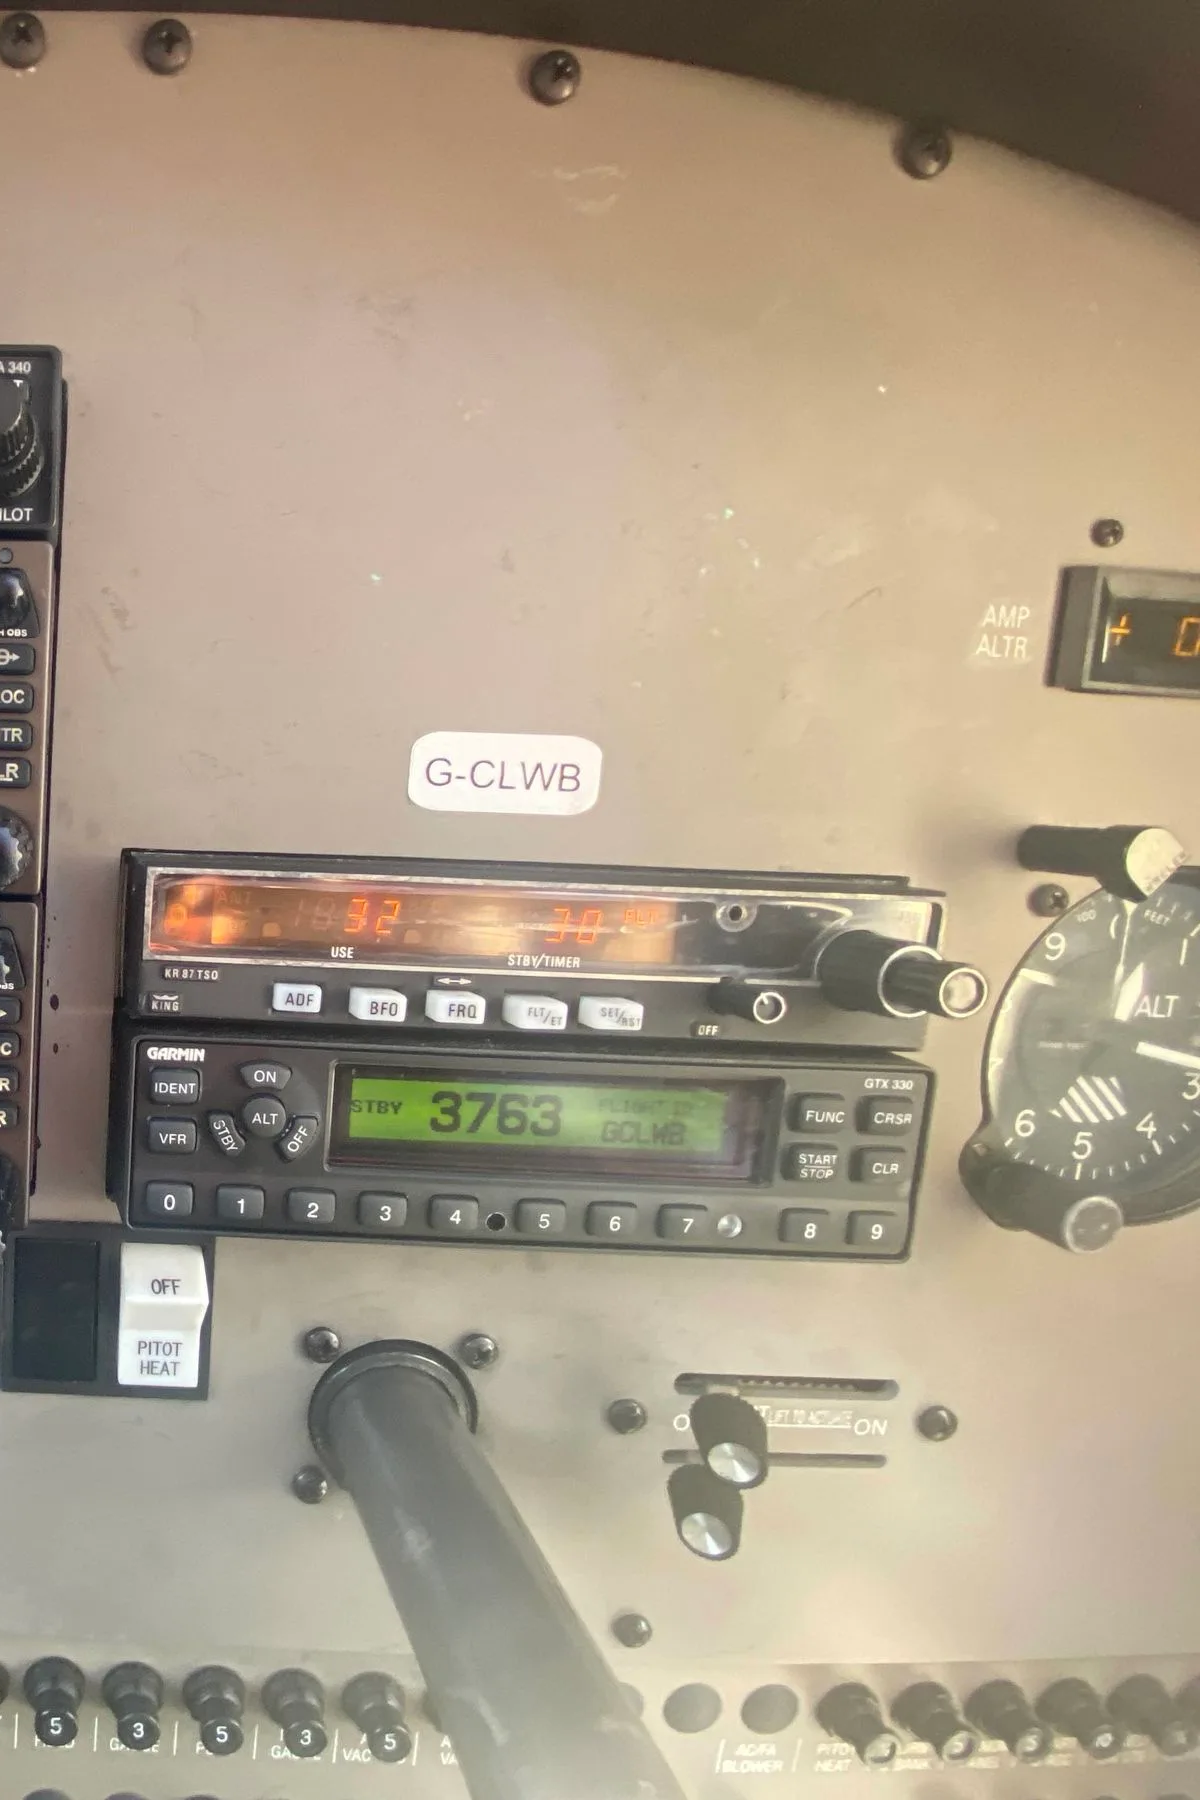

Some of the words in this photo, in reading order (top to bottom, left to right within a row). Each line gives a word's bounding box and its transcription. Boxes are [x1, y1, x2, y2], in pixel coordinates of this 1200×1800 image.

[8, 361, 31, 373] 340
[982, 605, 1030, 629] AMP
[7, 629, 28, 637] OBS
[976, 633, 1028, 659] ALTR
[425, 757, 581, 792] G-CLWB
[1144, 910, 1171, 926] FEET
[330, 946, 354, 960] USE
[508, 954, 581, 968] STBY/TIMER
[165, 968, 179, 978] KR
[198, 970, 218, 980] TSO
[151, 1001, 179, 1011] KING
[285, 993, 314, 1006] ADF
[370, 1001, 399, 1017] BFO
[448, 1003, 477, 1019] FRQ
[1134, 995, 1181, 1020] ALT
[697, 1025, 719, 1037] OFF
[146, 1047, 206, 1063] GARMIN
[253, 1069, 277, 1083] ON
[154, 1081, 195, 1095] IDENT
[864, 1078, 889, 1091] GTX
[892, 1079, 914, 1092] 330
[251, 1111, 279, 1126] ALT
[351, 1100, 404, 1115] STBY
[430, 1090, 564, 1138] 3763
[806, 1110, 845, 1125] FUNC
[874, 1112, 912, 1125] CRSR
[158, 1131, 187, 1146] VFR
[212, 1119, 239, 1154] STBY
[287, 1125, 310, 1154] OFF
[799, 1153, 838, 1166] START
[799, 1167, 834, 1180] STOP
[872, 1162, 899, 1176] CLR
[151, 1279, 181, 1294] OFF
[137, 1341, 183, 1357] PITOT
[139, 1360, 181, 1376] HEAT
[854, 1418, 888, 1437] ON
